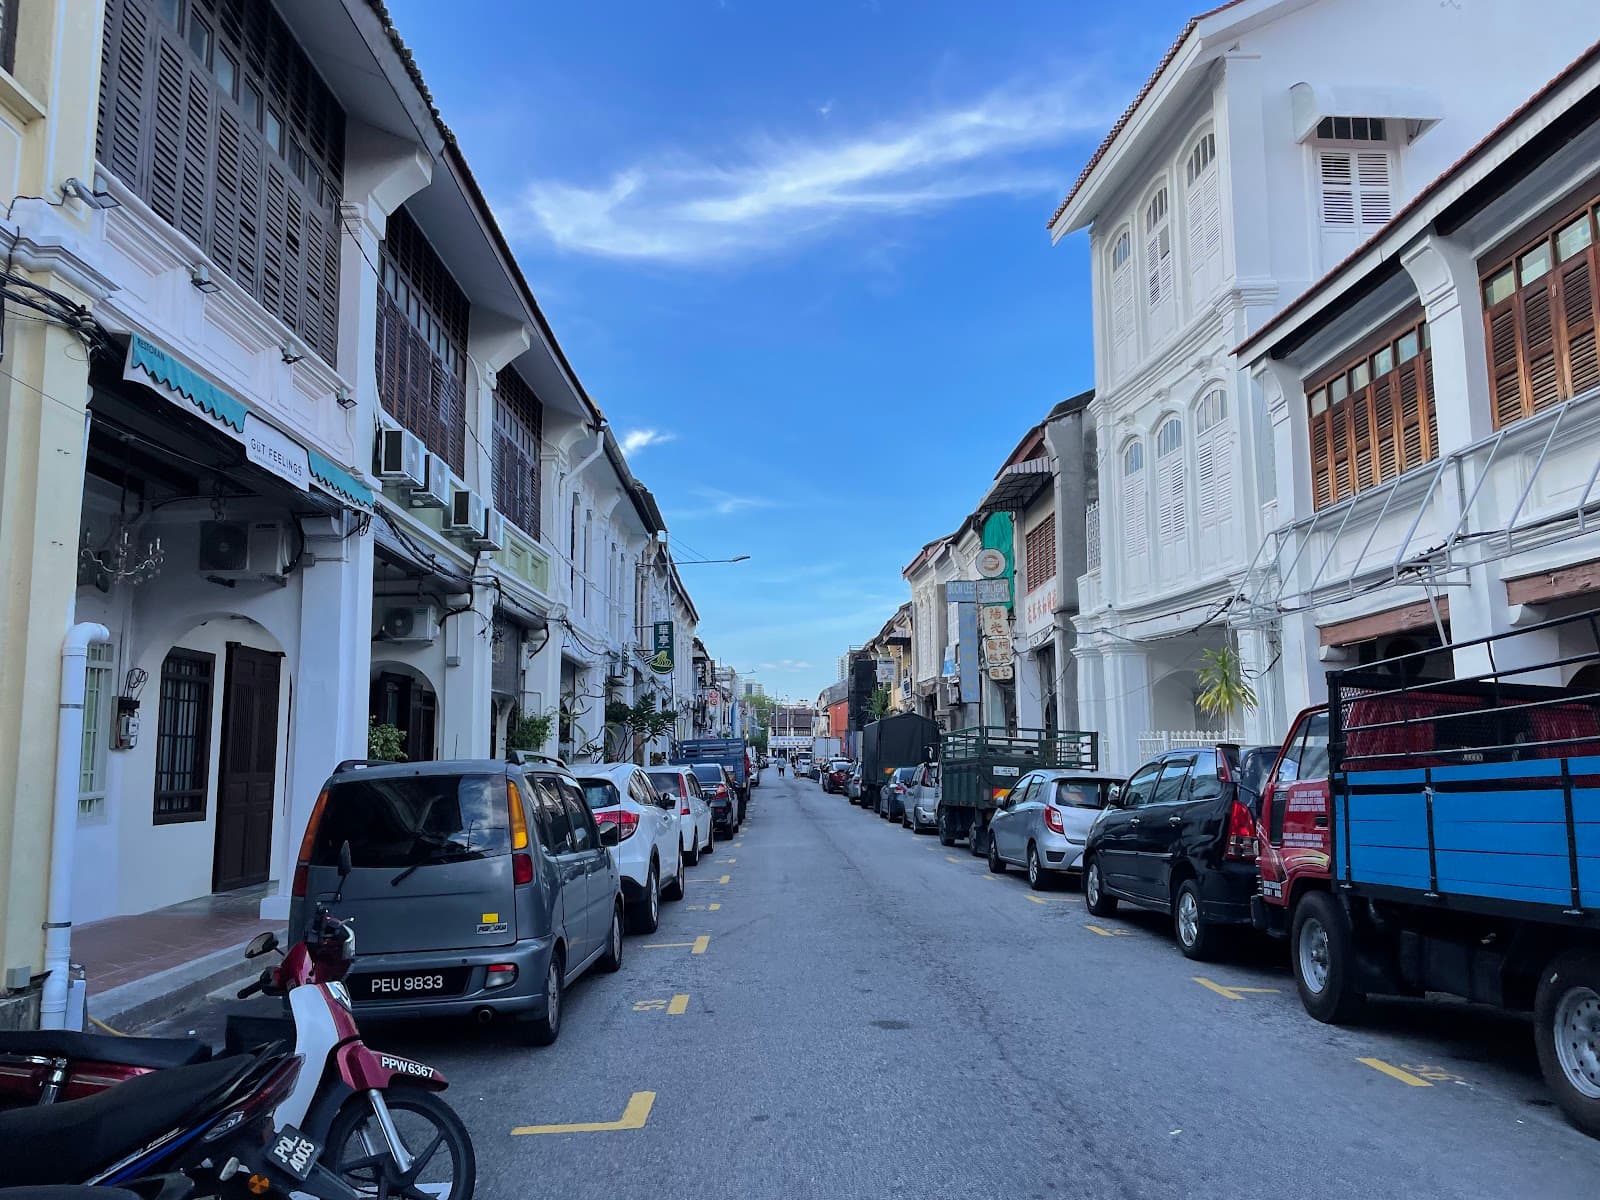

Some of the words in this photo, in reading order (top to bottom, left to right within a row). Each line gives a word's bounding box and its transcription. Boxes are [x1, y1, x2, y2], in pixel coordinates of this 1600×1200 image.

[137, 337, 165, 362] RESTORAN
[269, 448, 303, 477] FEELINGS
[371, 978, 401, 993] PEU
[403, 975, 444, 990] 9833
[289, 1139, 315, 1172] 4003
